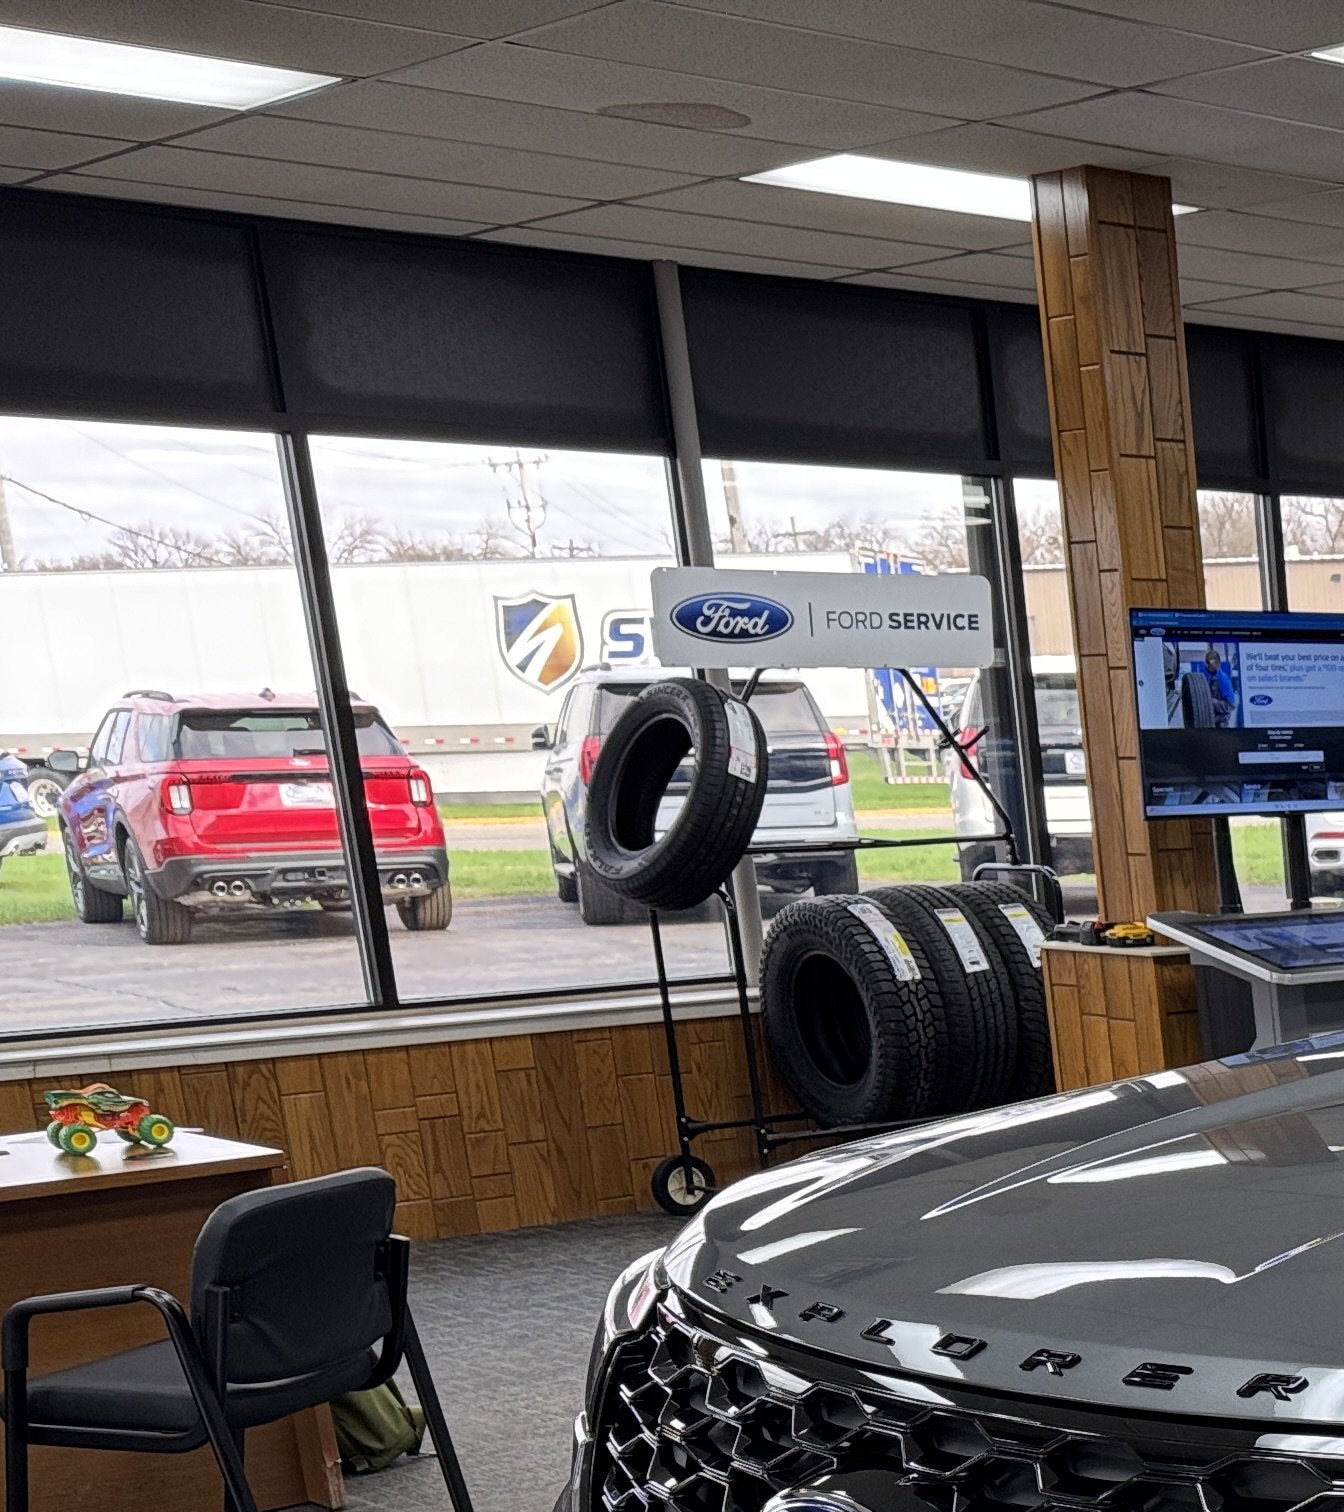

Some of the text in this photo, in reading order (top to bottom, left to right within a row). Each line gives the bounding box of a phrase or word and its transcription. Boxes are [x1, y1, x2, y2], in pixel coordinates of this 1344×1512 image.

[695, 599, 770, 636] Ford
[825, 610, 980, 632] FORD SERVICE
[703, 1270, 1310, 1401] EXPLORER
